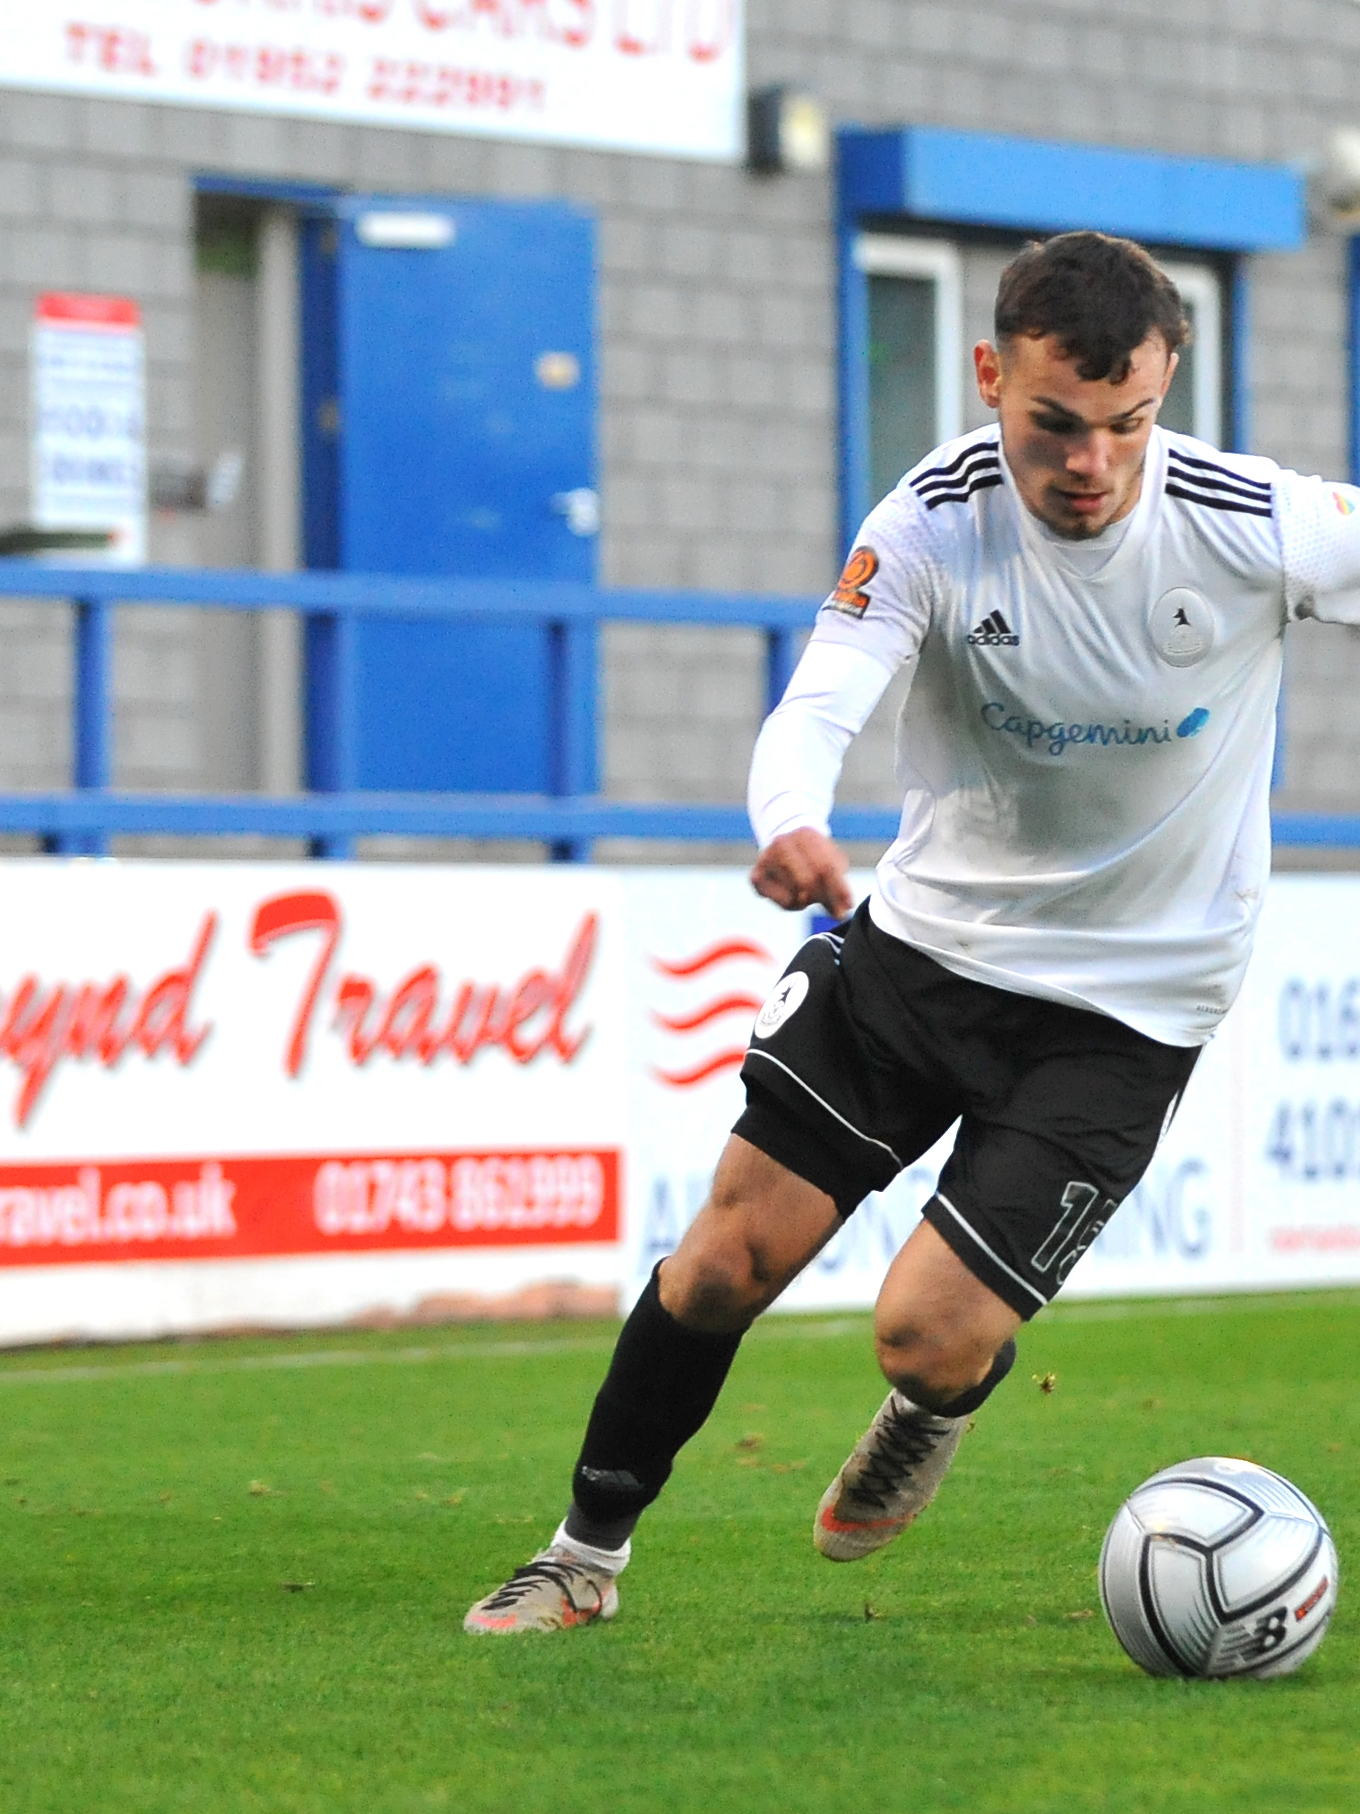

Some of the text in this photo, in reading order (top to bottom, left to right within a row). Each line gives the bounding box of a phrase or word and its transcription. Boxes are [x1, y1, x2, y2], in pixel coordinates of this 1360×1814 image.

[65, 20, 156, 78] TEL
[967, 634, 1020, 647] adidas
[981, 702, 1172, 757] Capgemini
[247, 888, 598, 1080] Travel
[313, 1158, 446, 1236] 01743
